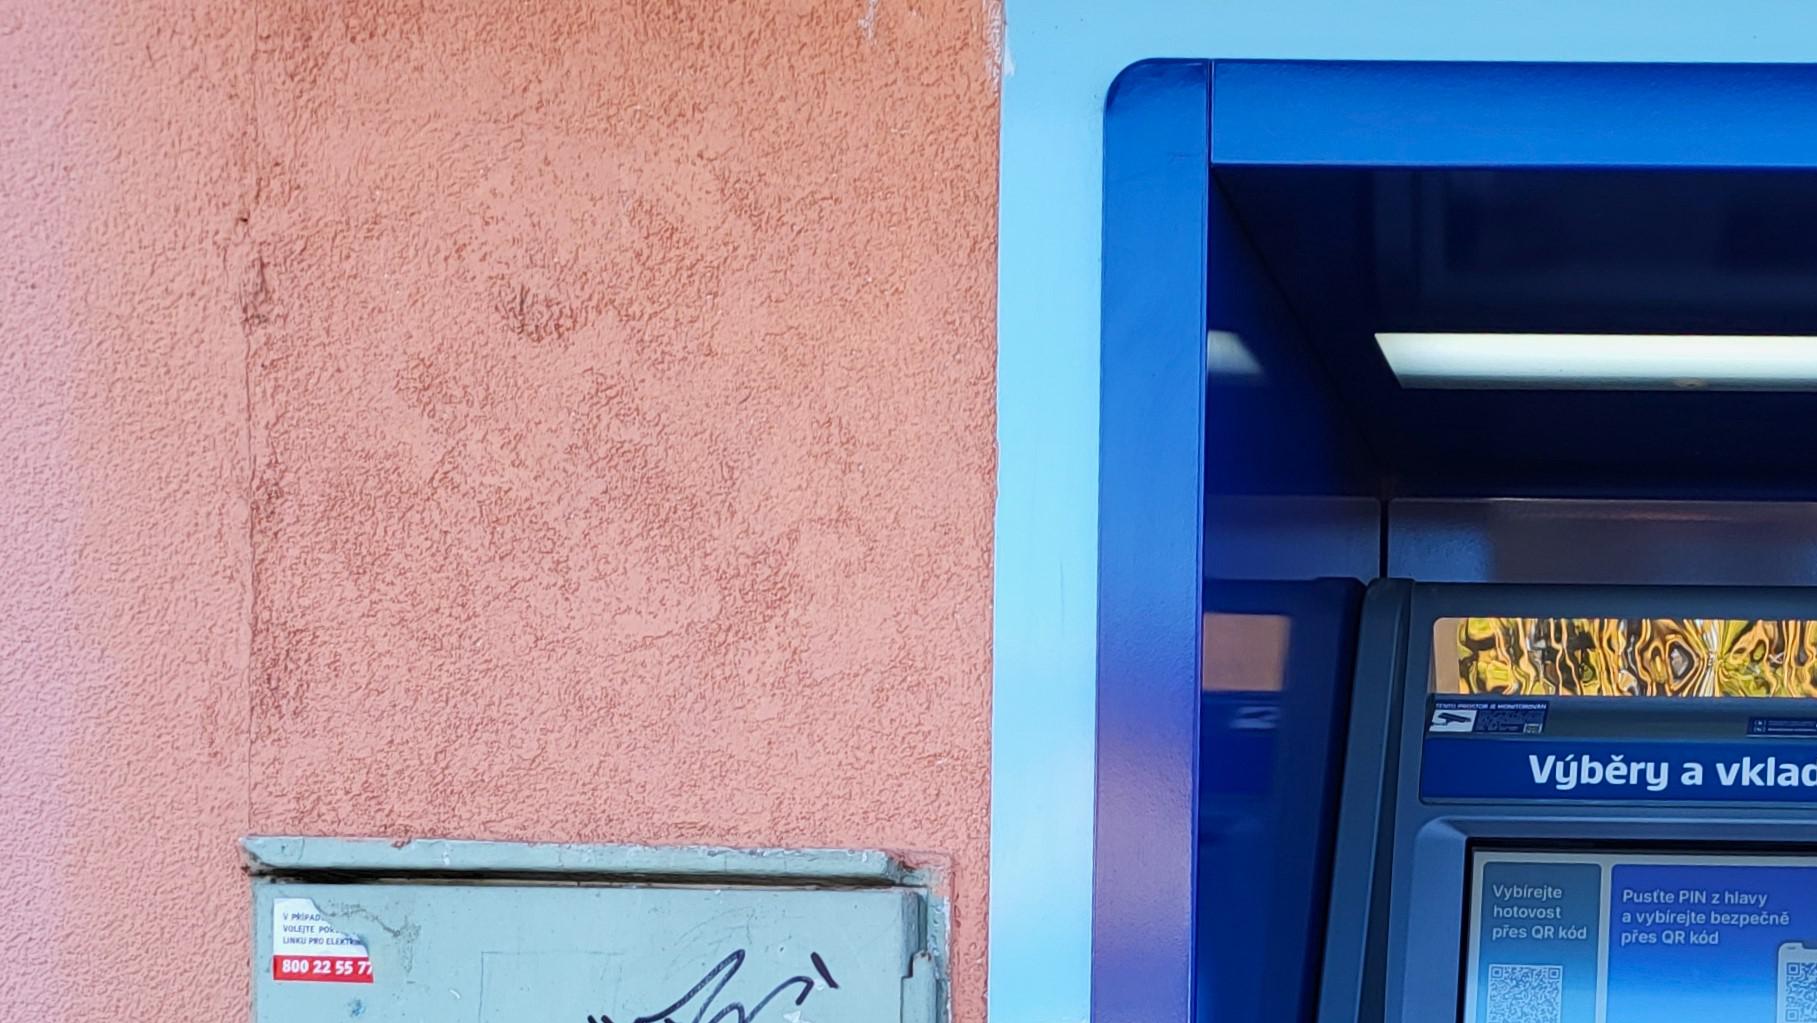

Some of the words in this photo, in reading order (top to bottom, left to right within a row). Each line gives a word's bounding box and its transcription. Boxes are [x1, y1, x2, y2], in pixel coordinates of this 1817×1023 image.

[1528, 753, 1670, 791] Výběry
[1681, 760, 1703, 786] a
[1492, 884, 1562, 901] Vybírejte
[1622, 889, 1675, 904] Pusťte
[1679, 890, 1706, 904] PIN
[1711, 894, 1720, 905] z
[1725, 891, 1768, 908] hlavy
[1493, 904, 1561, 919] hotovost
[1622, 911, 1631, 924] a
[1636, 909, 1705, 926] vybírejte
[1710, 910, 1790, 928] bezpečně
[283, 924, 314, 934] VOLEJTE
[1492, 924, 1527, 941] přes
[1531, 925, 1555, 939] QR
[1558, 924, 1587, 939] kód
[1621, 929, 1657, 946] přes
[1662, 930, 1685, 945] QR
[1689, 929, 1719, 945] kód
[282, 937, 307, 945] LINKU
[308, 937, 324, 945] PRO
[282, 959, 309, 973] 800
[312, 960, 331, 974] 22
[335, 960, 354, 975] 55
[357, 961, 373, 975] 77
